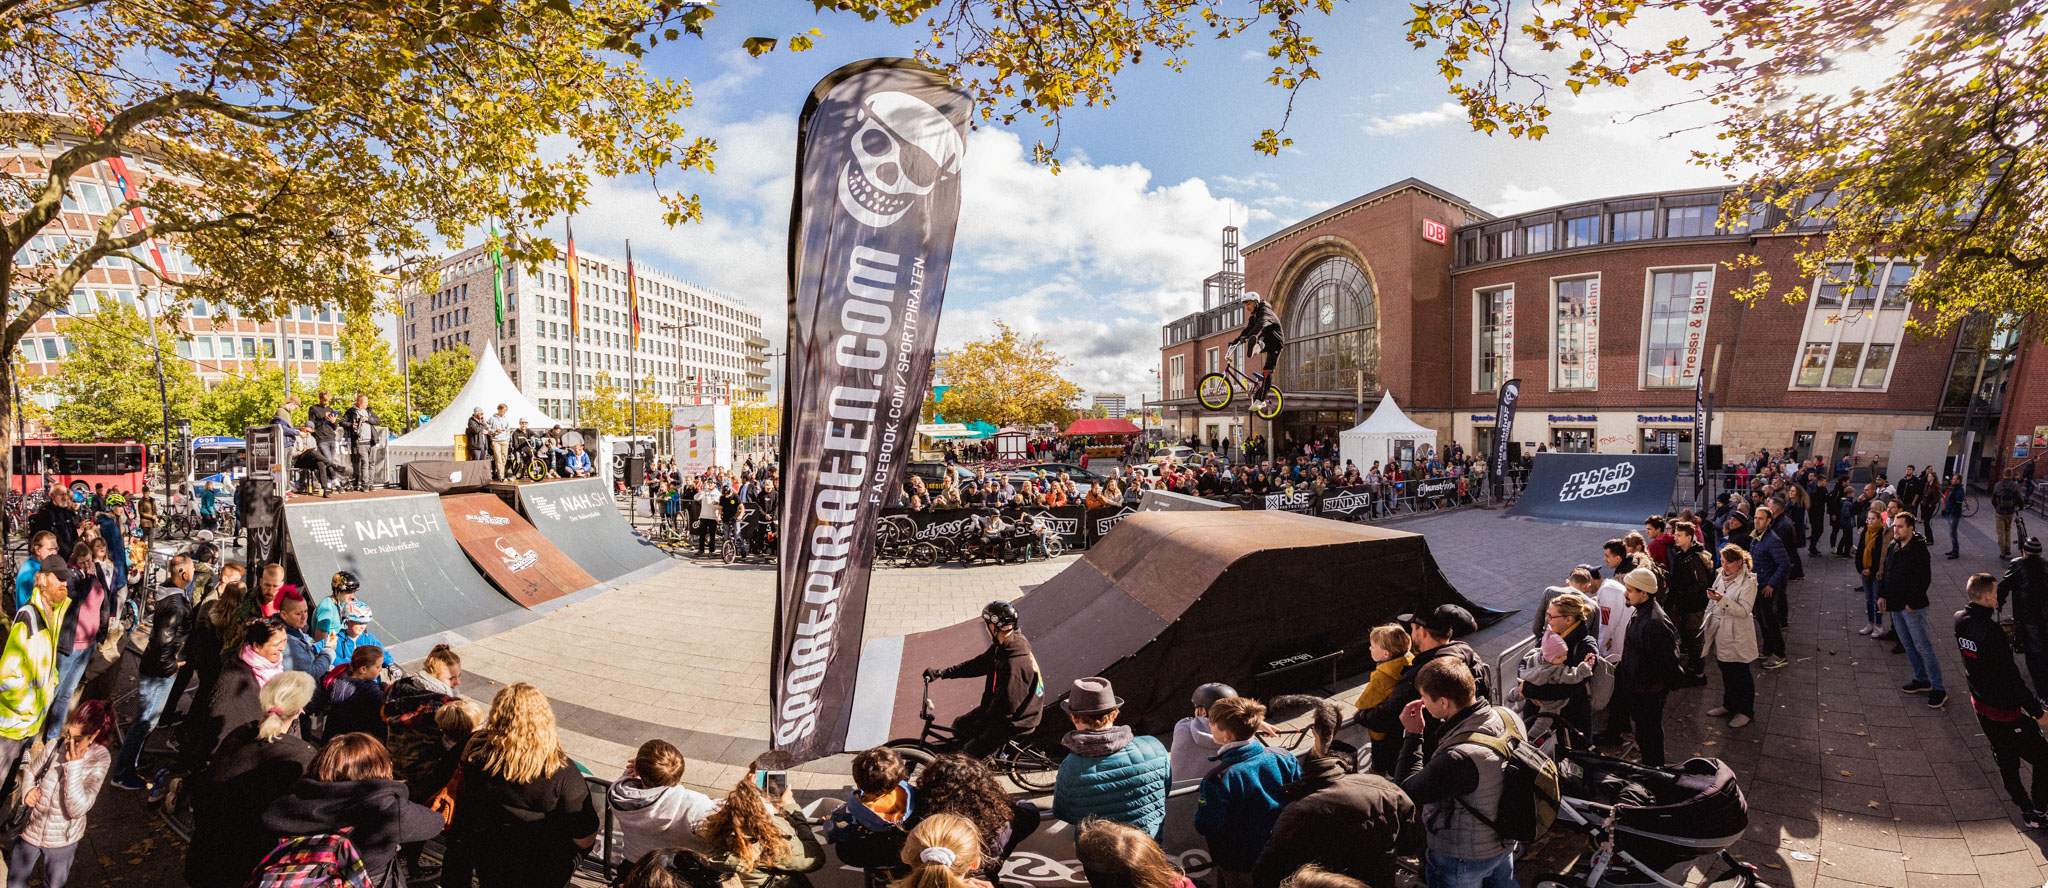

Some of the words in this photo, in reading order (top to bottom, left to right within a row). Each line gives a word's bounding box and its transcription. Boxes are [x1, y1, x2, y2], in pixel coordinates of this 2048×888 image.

[1427, 223, 1444, 241] DB
[1587, 283, 1598, 316] Hahn
[1691, 281, 1708, 314] Buch
[1504, 297, 1513, 328] Buch
[1587, 319, 1597, 327] &
[1689, 319, 1702, 328] &
[1585, 331, 1597, 380] Schmitt
[1682, 332, 1700, 378] Presse
[1547, 414, 1598, 422] Sparda-Bank
[1637, 414, 1695, 423] Sparda-Bank
[560, 491, 609, 512] NAH.SH
[1279, 493, 1309, 506] FUSE
[1324, 495, 1367, 510] SUNDAY
[354, 513, 440, 541] NAH.SH
[362, 546, 378, 555] Der
[378, 541, 420, 553] Nahverkehr
